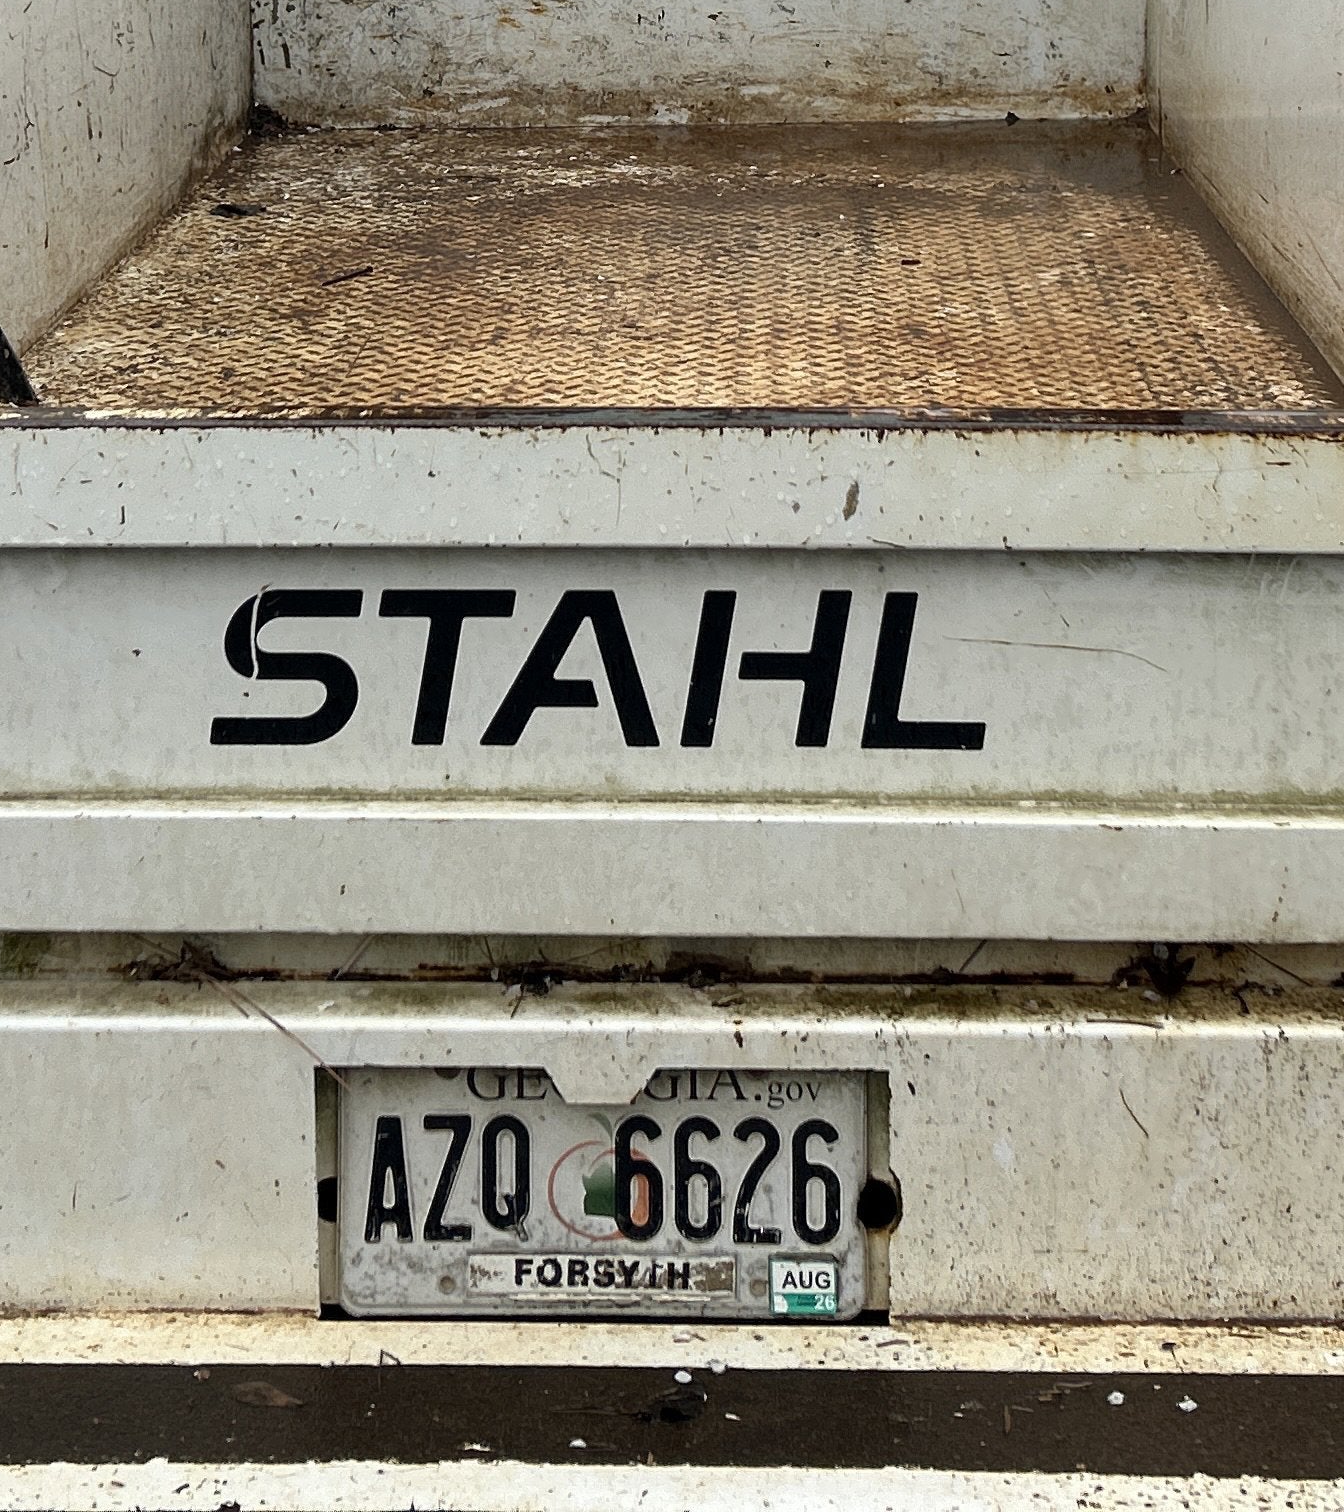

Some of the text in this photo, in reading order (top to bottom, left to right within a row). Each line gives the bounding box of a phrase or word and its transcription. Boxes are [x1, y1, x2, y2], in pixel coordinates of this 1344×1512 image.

[210, 589, 987, 750] STAHL
[466, 1067, 823, 1110] GEGIA.gov
[364, 1114, 842, 1245] AZQ 6626
[781, 1270, 831, 1290] AUG
[814, 1293, 836, 1311] 26
